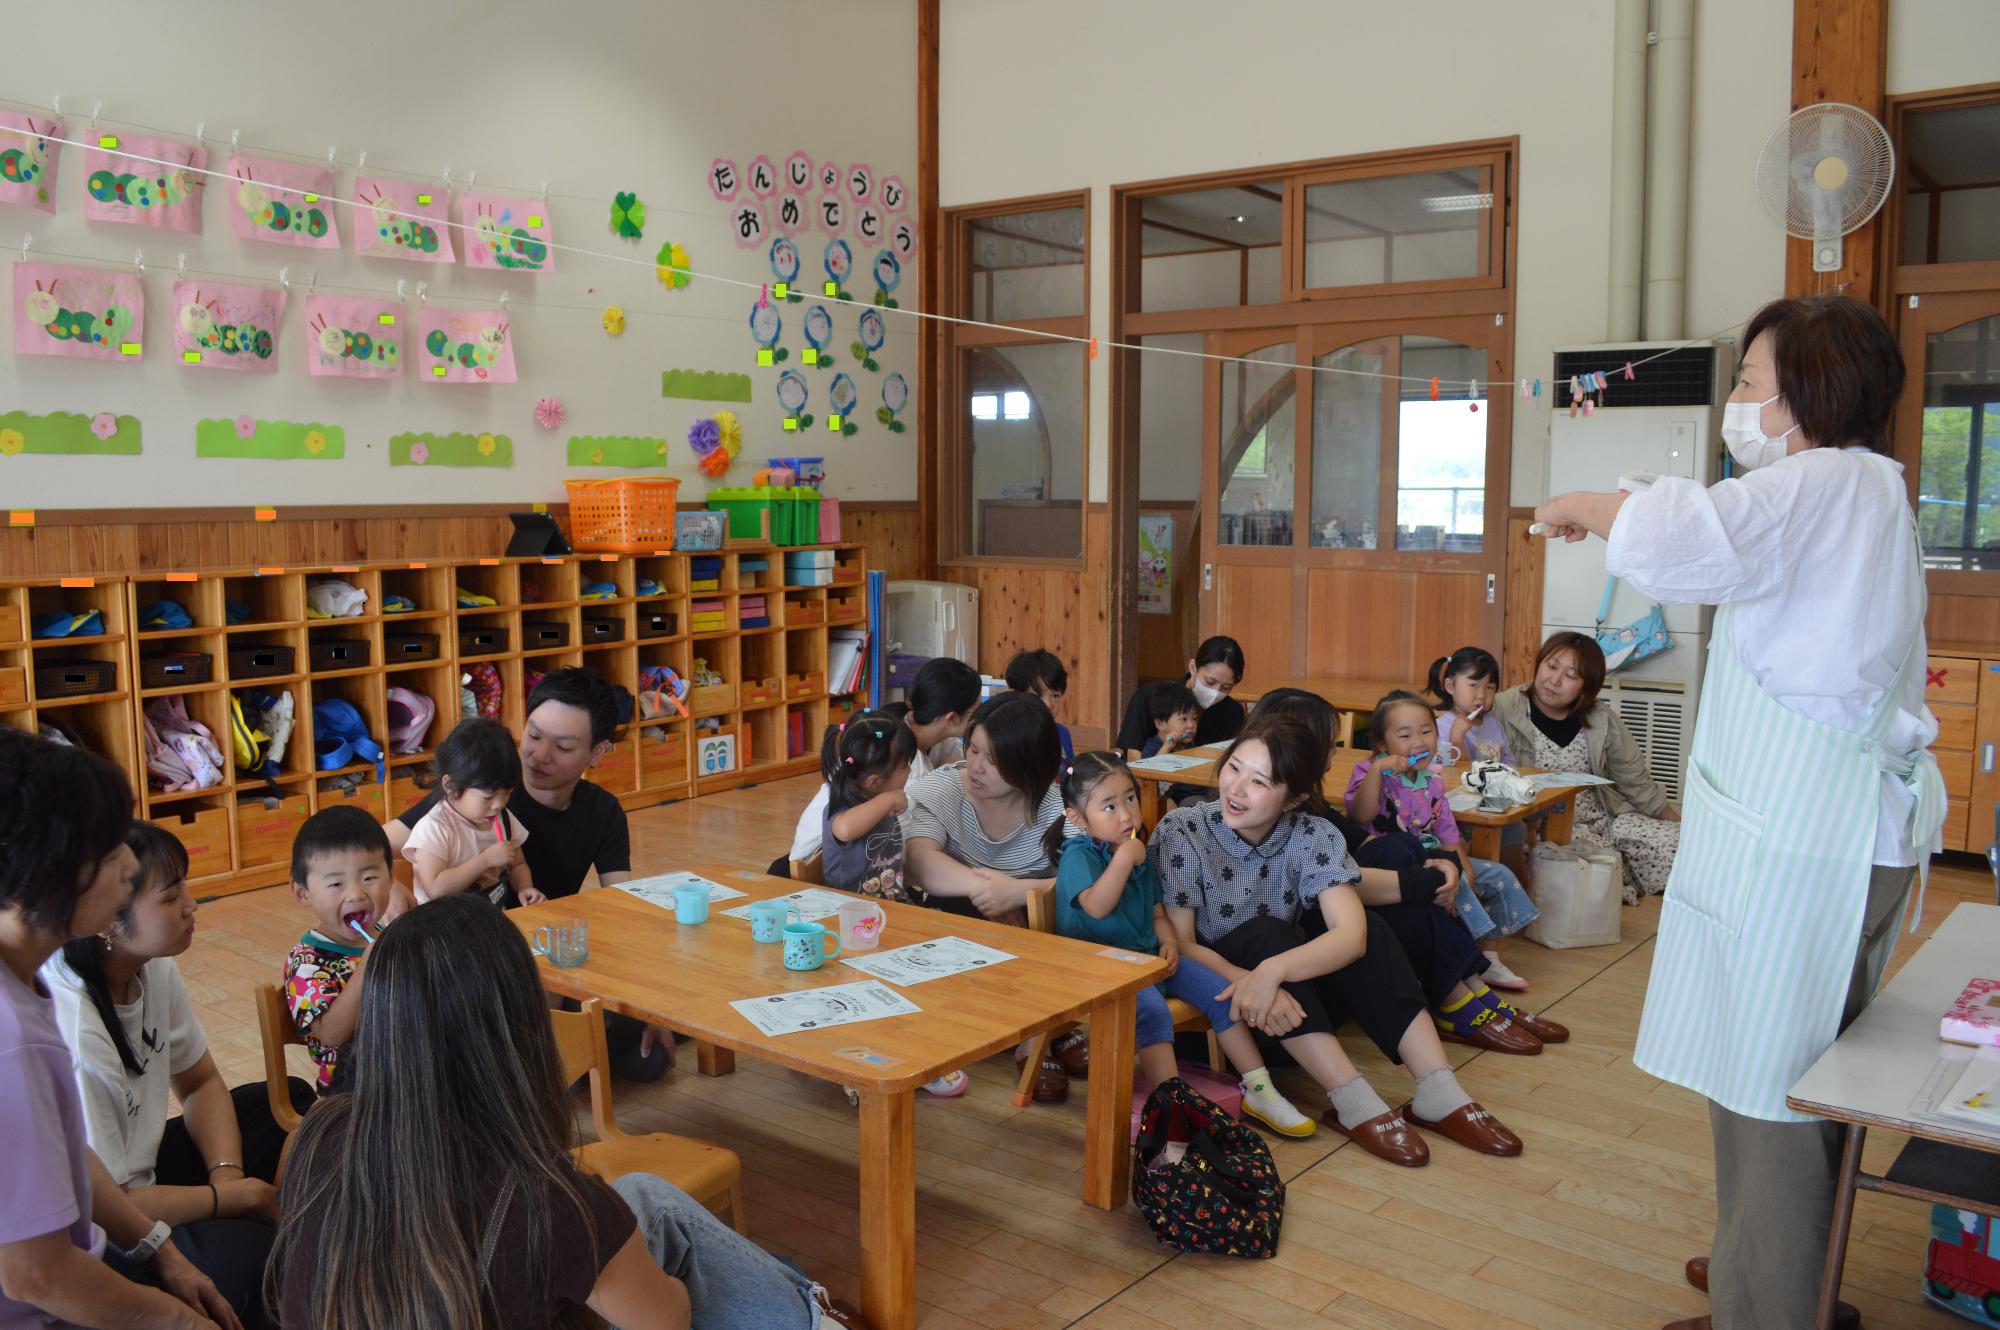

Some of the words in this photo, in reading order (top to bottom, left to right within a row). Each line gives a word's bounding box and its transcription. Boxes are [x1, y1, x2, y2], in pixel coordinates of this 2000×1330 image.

[714, 163, 902, 206] たんじょうび
[738, 197, 911, 252] おめでとう
